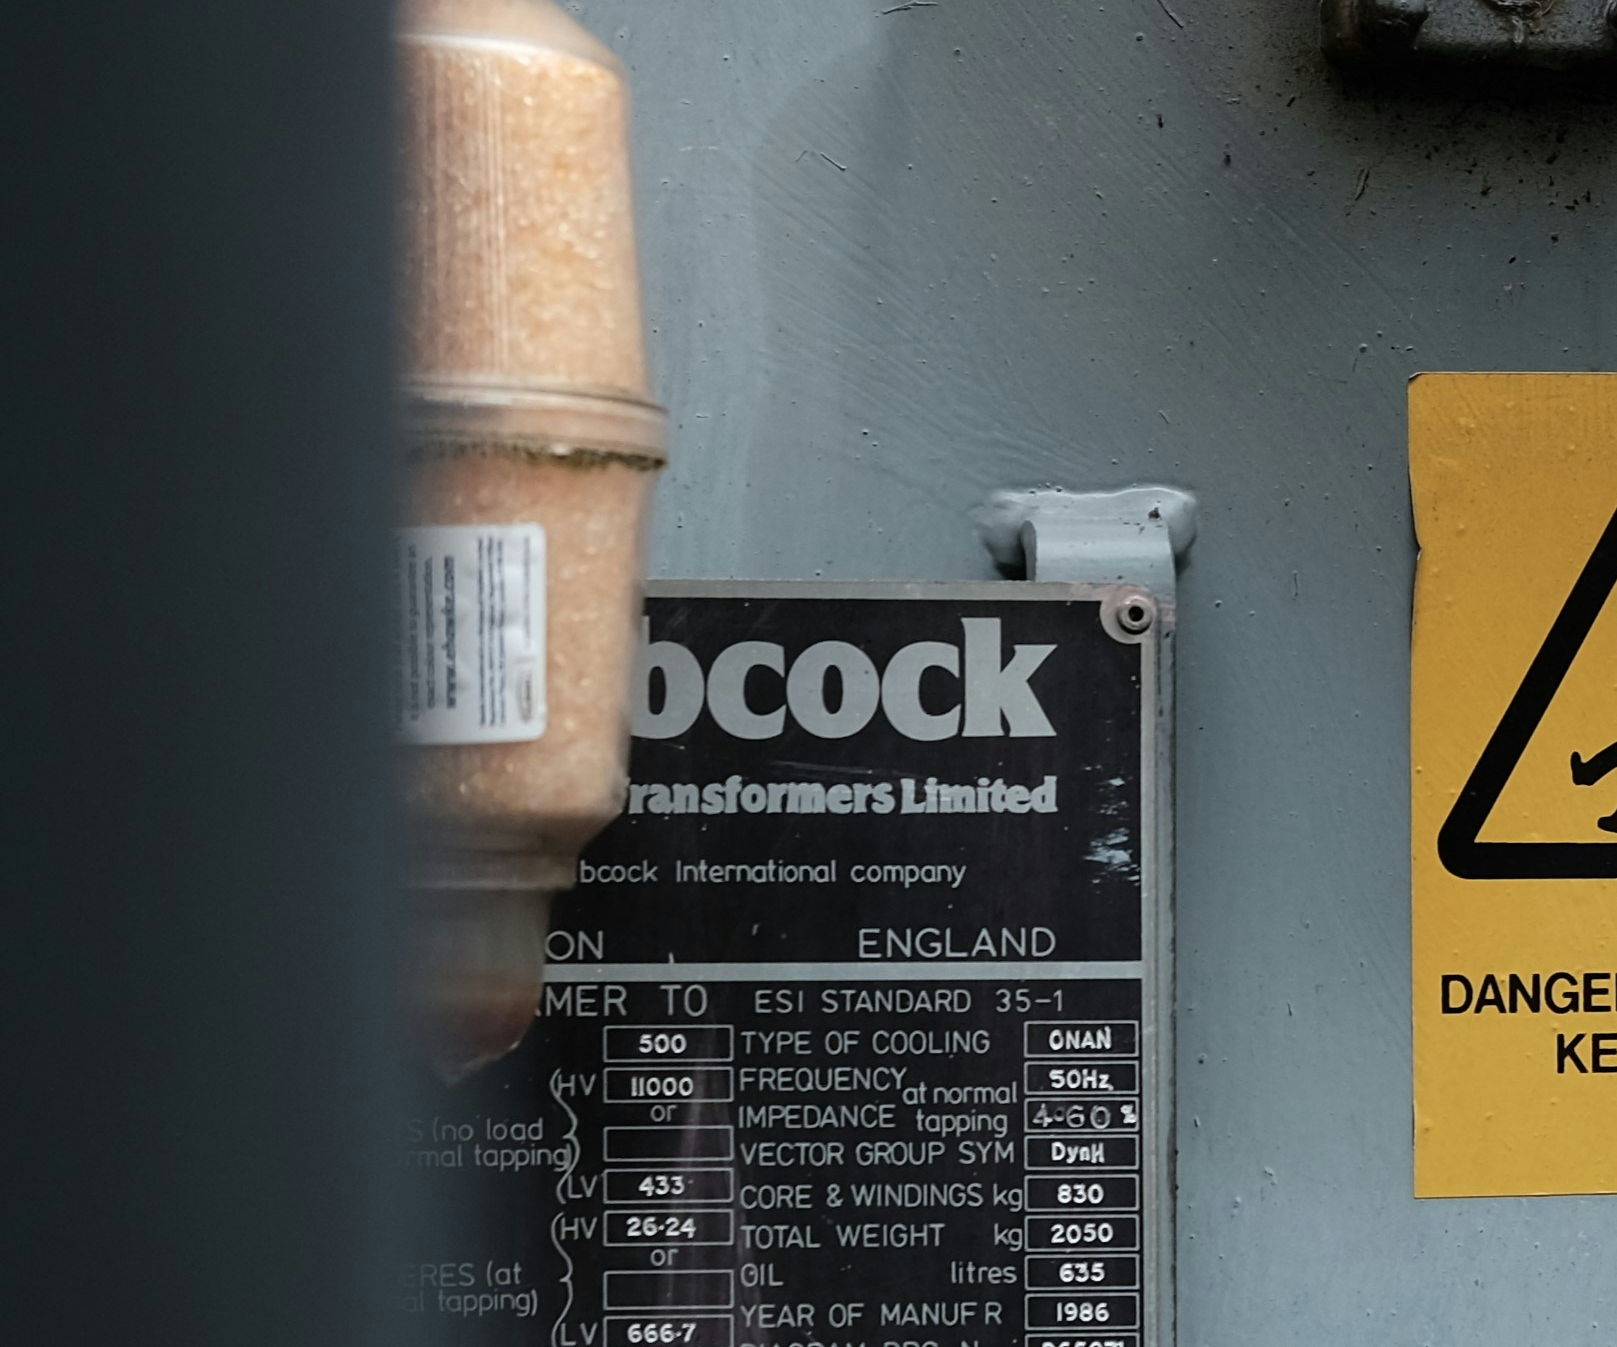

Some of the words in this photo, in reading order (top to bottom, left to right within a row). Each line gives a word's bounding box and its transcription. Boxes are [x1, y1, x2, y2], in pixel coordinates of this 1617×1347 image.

[625, 767, 894, 816] ransformers
[900, 774, 1058, 815] Limited
[675, 858, 837, 884] International
[851, 861, 967, 889] company
[859, 927, 1057, 960] ENGLAND
[536, 984, 628, 1018] MER
[662, 983, 709, 1018] TO
[754, 988, 805, 1014] ESI
[821, 988, 973, 1015] STANDARD
[995, 988, 1065, 1014] 35-1
[638, 1032, 687, 1056] 500
[741, 1031, 812, 1056] TYPE
[825, 1030, 859, 1057] OF
[873, 1028, 991, 1056] COOLING
[1048, 1024, 1113, 1053] ONAN
[556, 1074, 597, 1099] HV
[739, 1067, 907, 1094] FREQUENCY
[903, 1083, 927, 1107] at
[933, 1082, 1017, 1107] normal
[650, 1103, 677, 1124] or
[739, 1104, 896, 1130] IMPEDANCE
[917, 1107, 1008, 1138] tapping
[485, 1117, 543, 1141] load
[741, 1141, 843, 1167] VECTOR
[855, 1141, 947, 1167] GROUP
[958, 1140, 1014, 1165] SYM
[565, 1177, 597, 1200] LV
[638, 1172, 686, 1198] 433
[740, 1184, 812, 1209] CORE
[827, 1184, 843, 1208] &
[851, 1183, 984, 1208] WINDINGS
[993, 1181, 1023, 1213] kg
[1056, 1183, 1105, 1206] 830
[559, 1217, 597, 1241] HV
[740, 1224, 822, 1249] TOTAL
[835, 1222, 944, 1248] WEIGHT
[993, 1223, 1023, 1253] kg
[1049, 1221, 1114, 1244] 2050
[650, 1247, 678, 1267] or
[741, 1261, 784, 1287] OIL
[950, 1260, 1017, 1285] litres
[1057, 1262, 1105, 1285] 635
[438, 1289, 538, 1317] tapping)
[741, 1303, 816, 1329] YEAR
[828, 1303, 863, 1328] OF
[1055, 1301, 1110, 1324] 1986
[560, 1322, 597, 1347] LV
